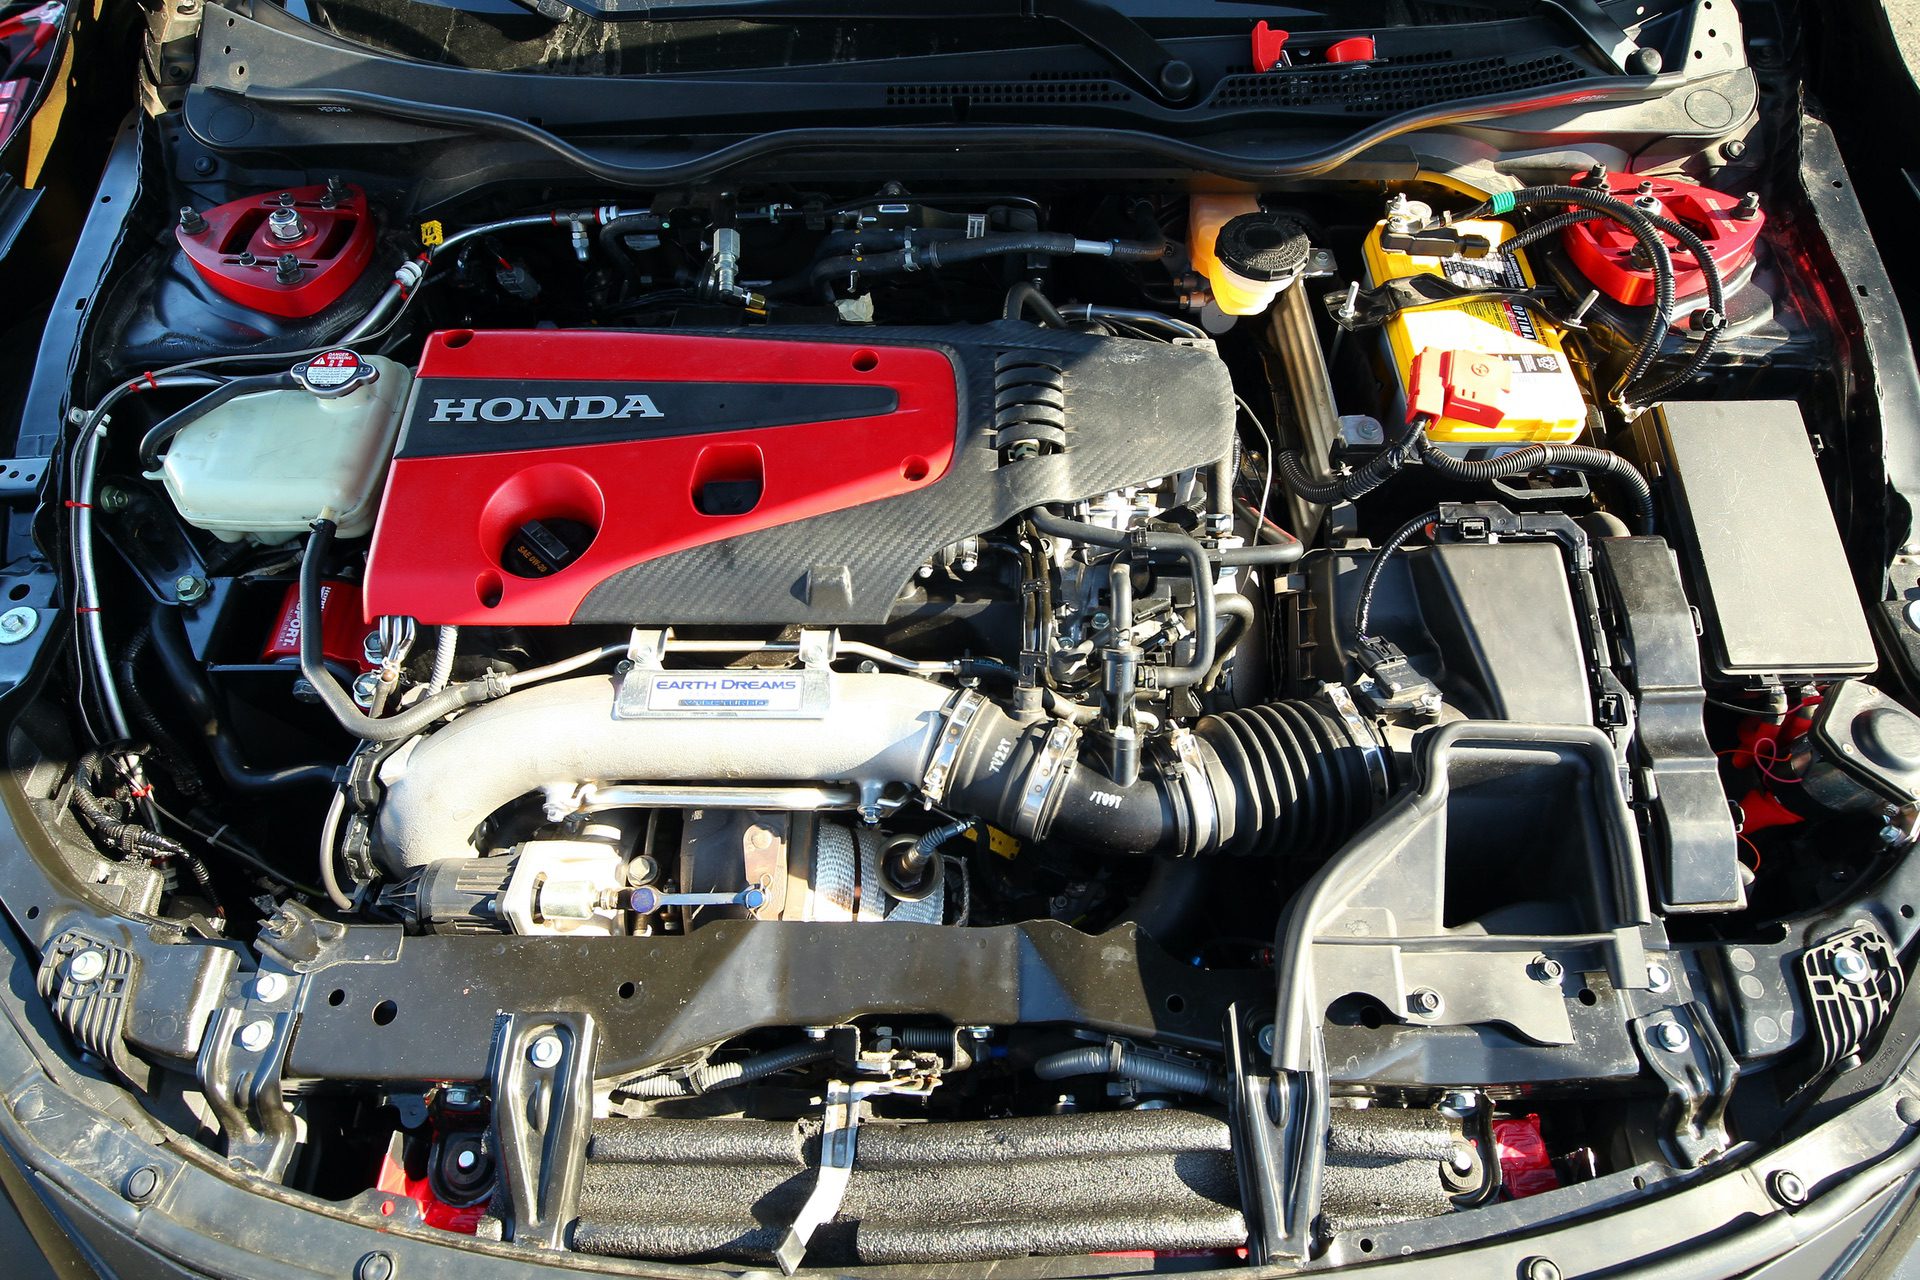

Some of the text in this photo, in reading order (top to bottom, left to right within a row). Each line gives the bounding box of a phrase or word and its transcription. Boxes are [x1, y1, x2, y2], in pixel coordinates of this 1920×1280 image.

[1512, 304, 1536, 340] OPTIMA
[428, 394, 665, 422] HONDA
[517, 545, 533, 559] SAE
[656, 679, 796, 690] EARTH DREAMS
